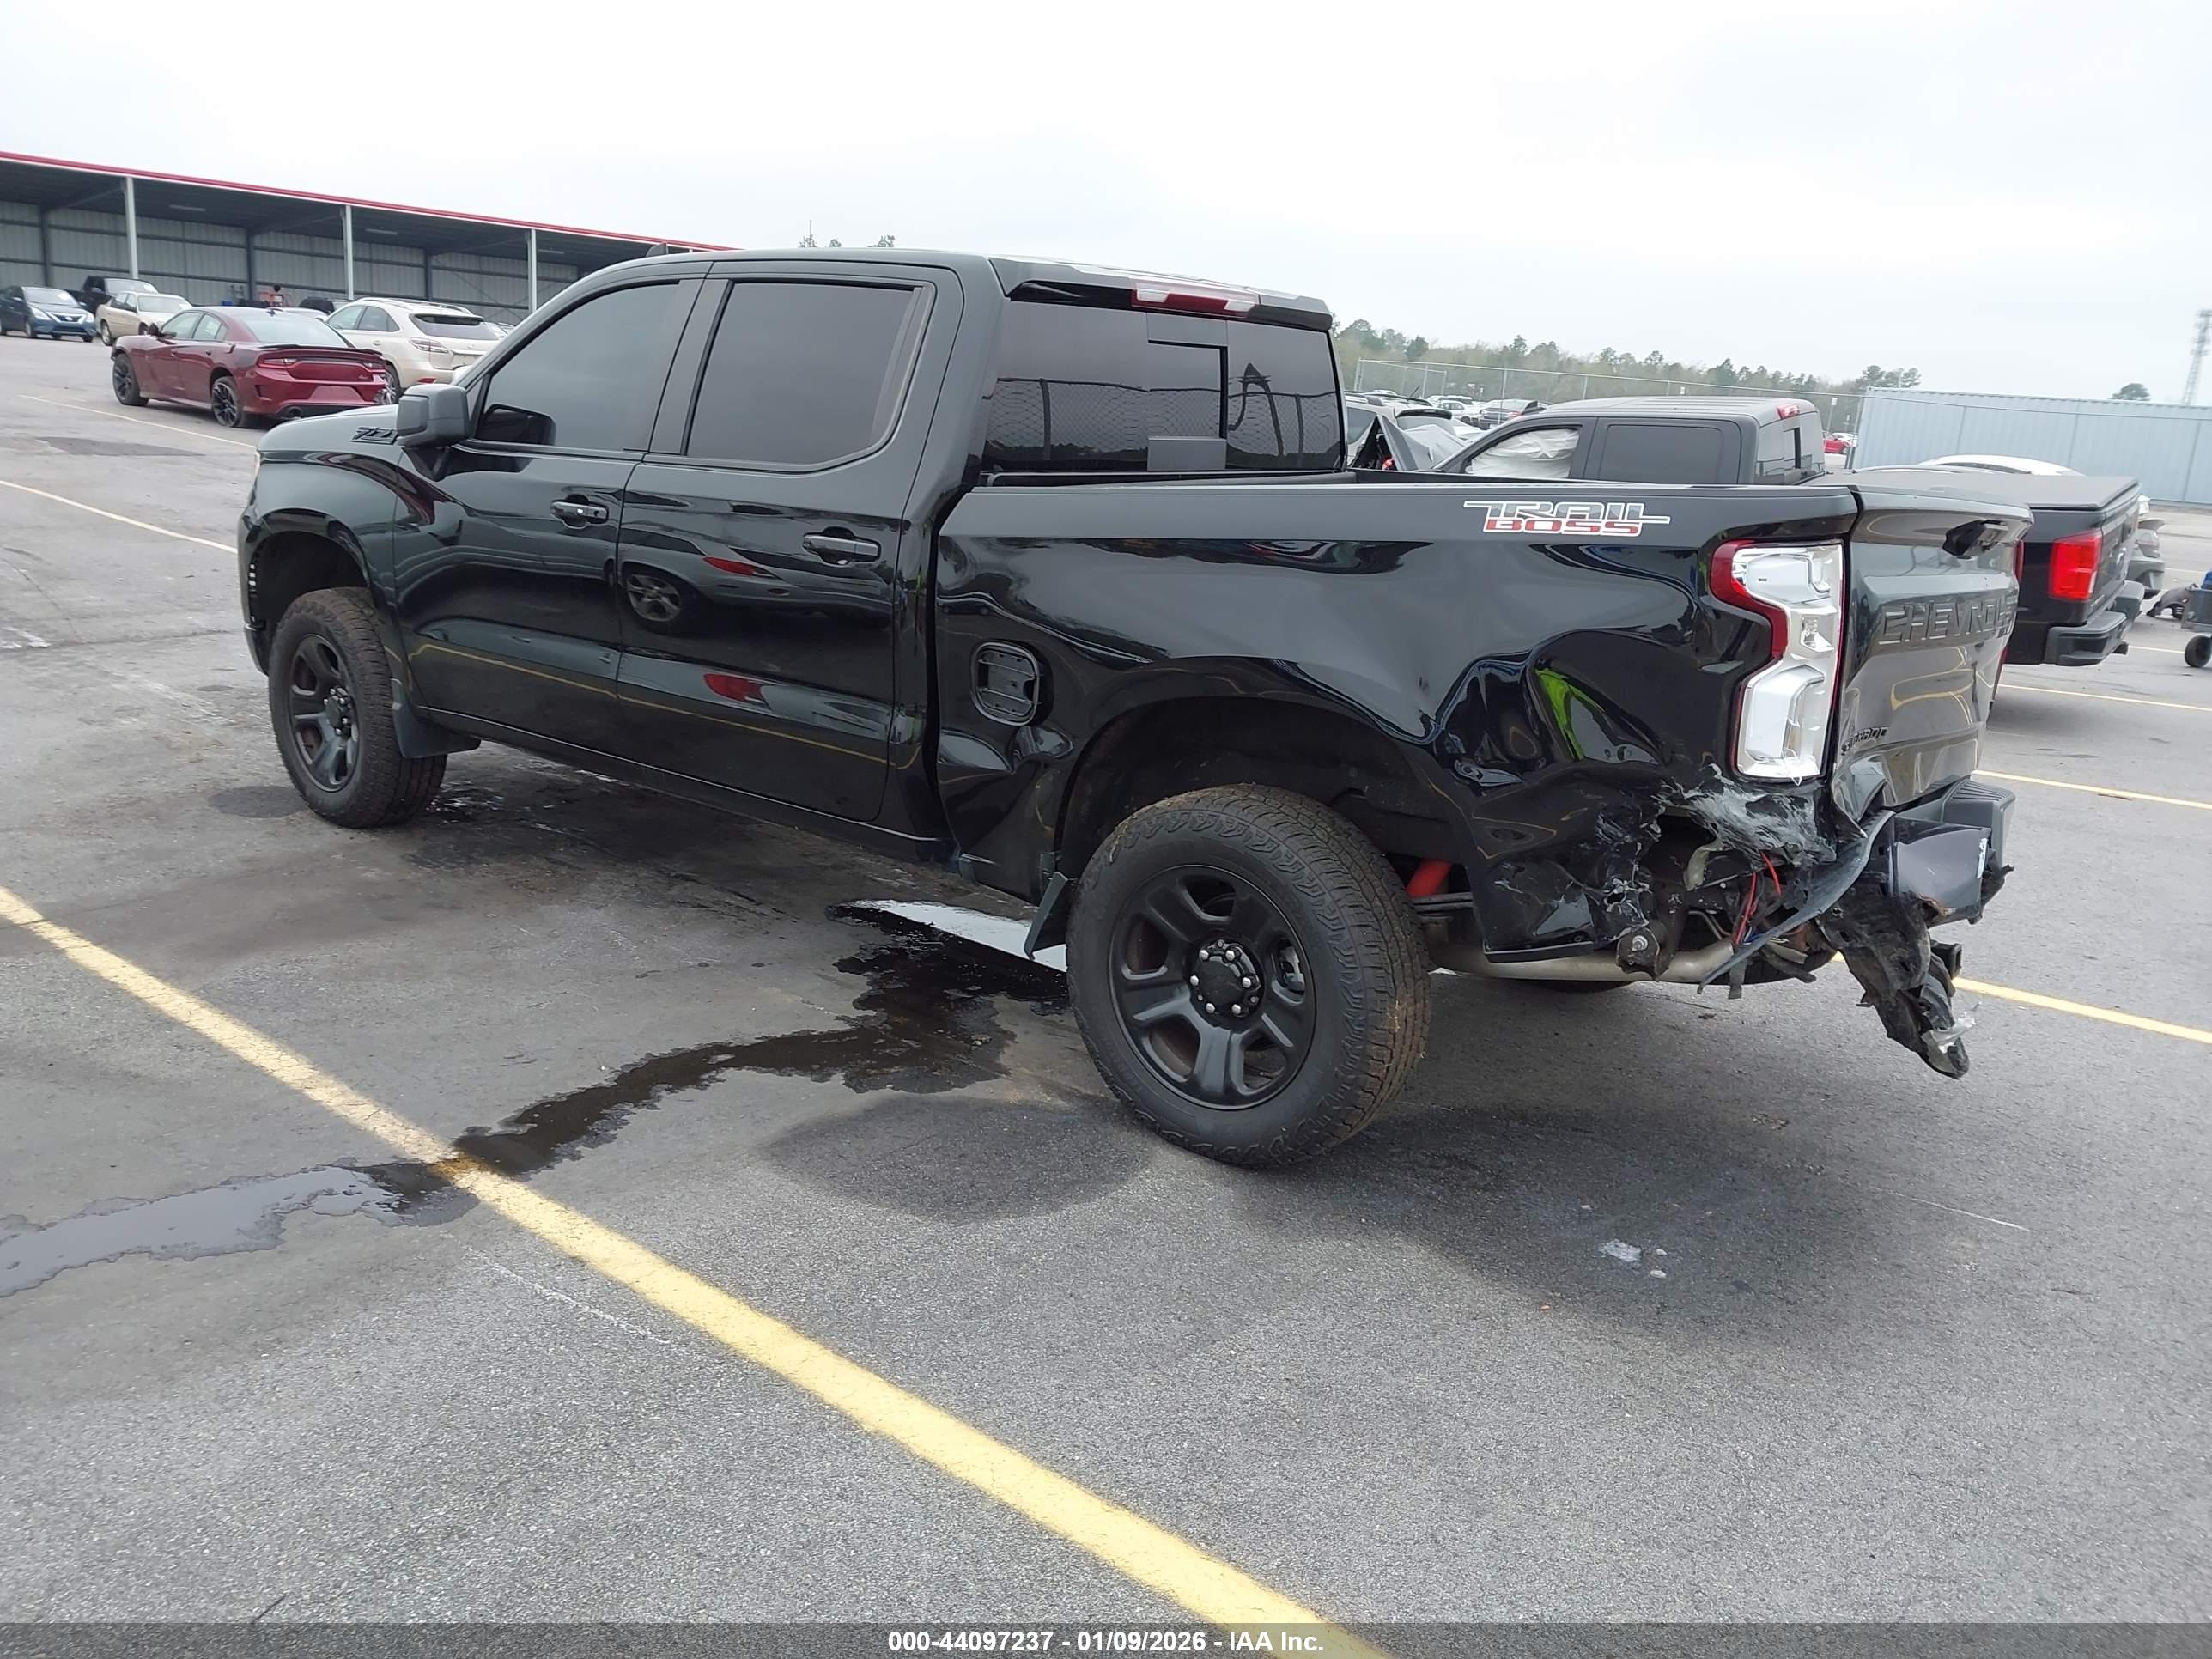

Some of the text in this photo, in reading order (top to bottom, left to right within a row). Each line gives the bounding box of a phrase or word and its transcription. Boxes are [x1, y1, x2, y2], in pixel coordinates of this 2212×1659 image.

[1463, 501, 1671, 524] TRAIL
[1483, 517, 1644, 537] BOSS
[1878, 592, 2018, 645] CHEVROLE
